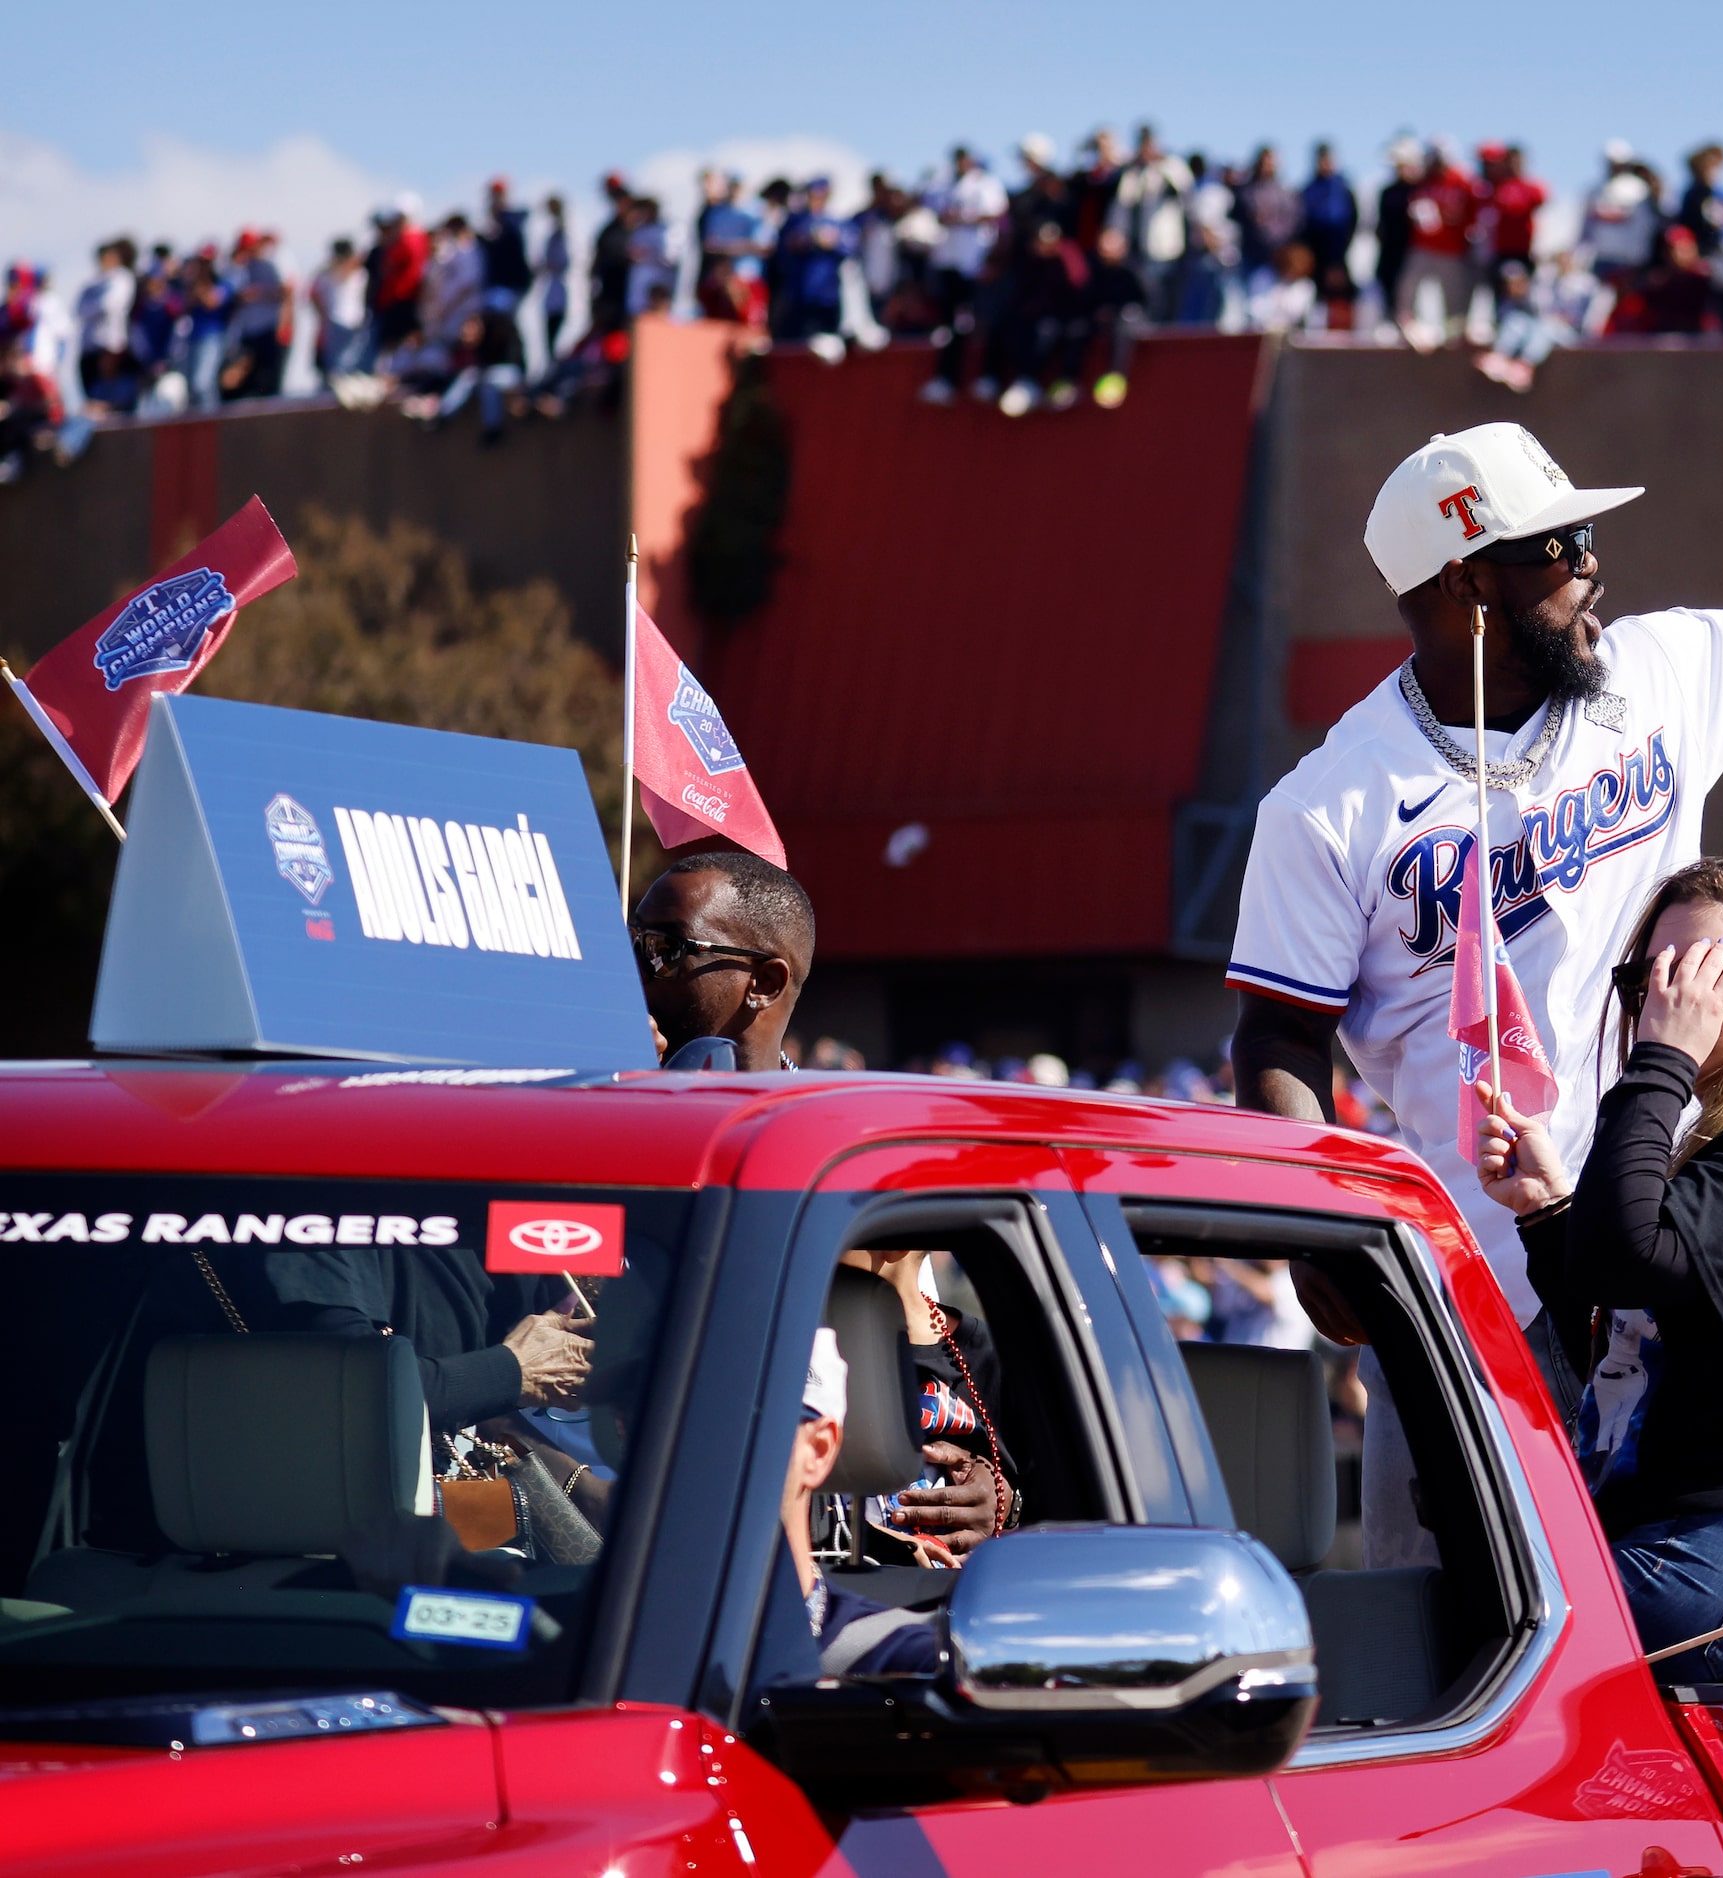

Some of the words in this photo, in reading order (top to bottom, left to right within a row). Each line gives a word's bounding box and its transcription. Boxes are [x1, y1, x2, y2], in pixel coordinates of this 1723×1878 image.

[1438, 484, 1486, 541] T
[124, 592, 192, 645] WORLD
[135, 589, 159, 614] T
[109, 589, 220, 675] CHAMPIONS
[699, 719, 712, 733] 20
[682, 783, 730, 823] Coca-Cola
[1387, 726, 1677, 958] Rangers
[333, 806, 469, 949] ADOLIS
[141, 1213, 459, 1245] RANGERS
